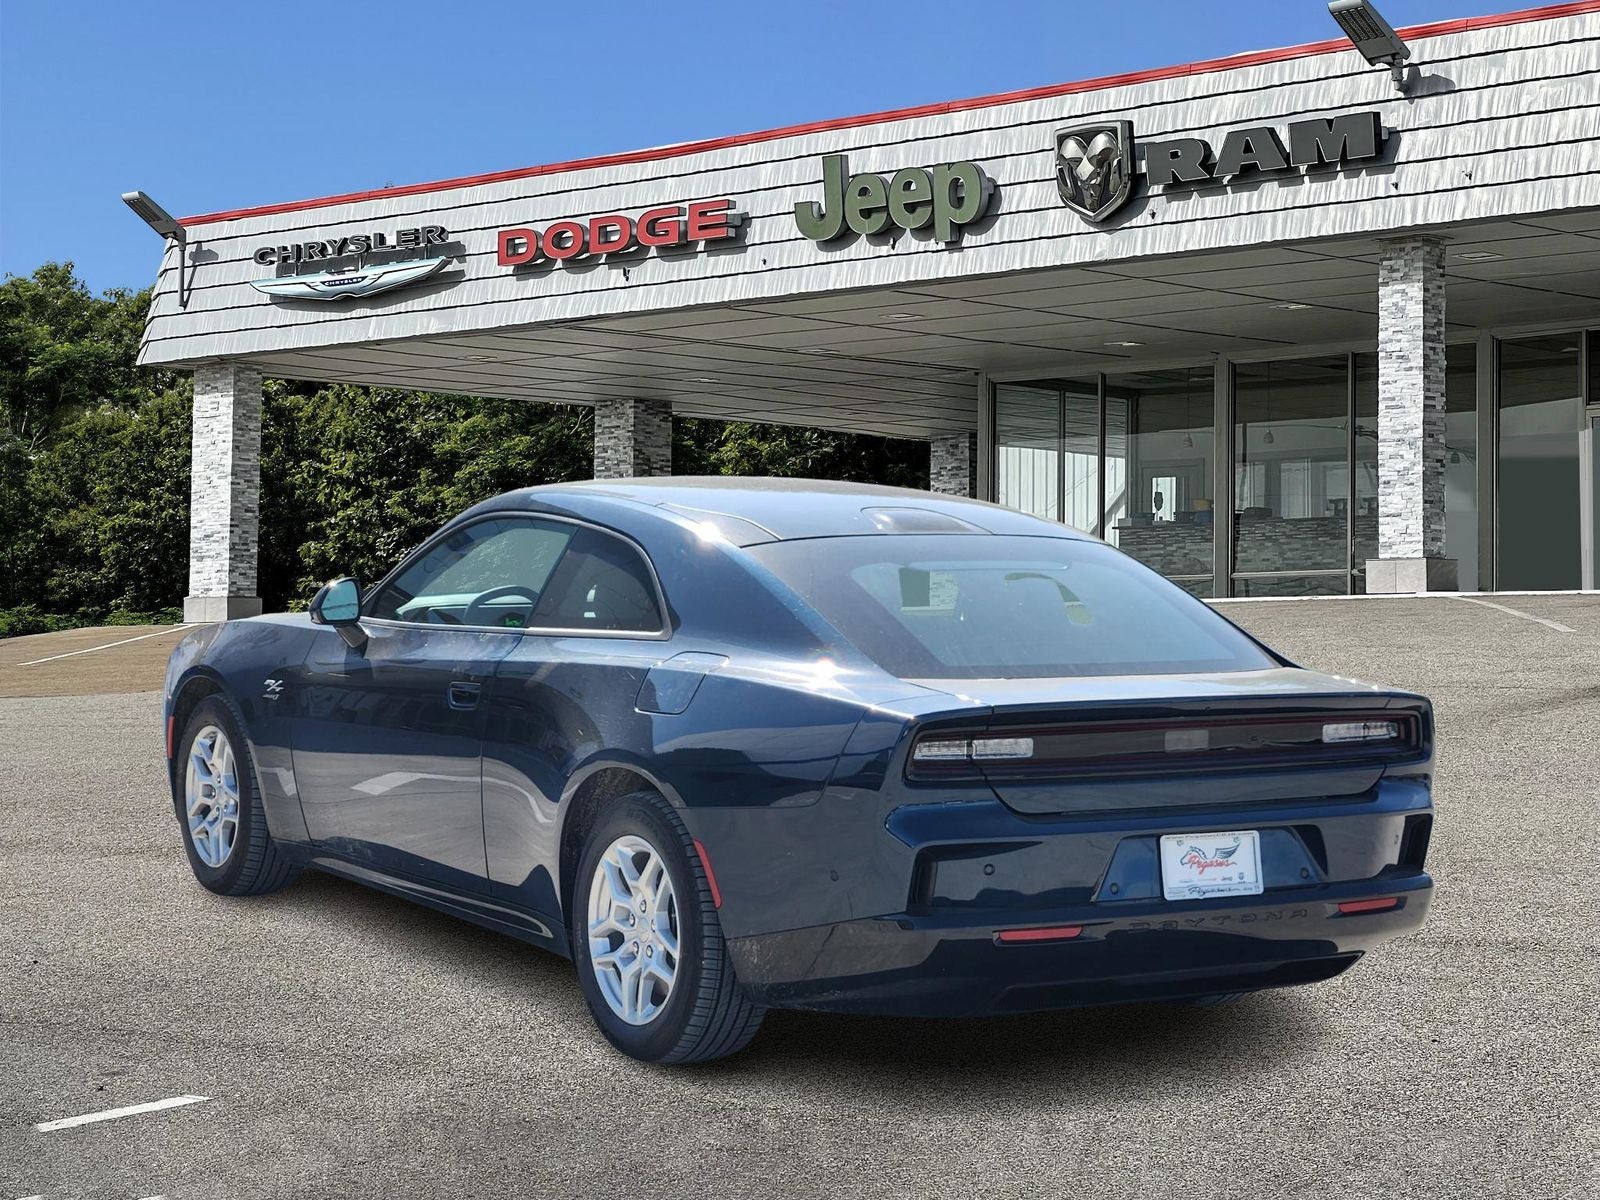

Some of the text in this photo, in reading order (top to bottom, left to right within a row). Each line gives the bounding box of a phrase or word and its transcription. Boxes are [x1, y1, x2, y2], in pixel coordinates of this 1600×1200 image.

[1144, 111, 1381, 186] RAM
[794, 154, 985, 243] Jeep
[253, 225, 448, 266] CHRYSLER
[498, 199, 736, 267] DODGE
[324, 277, 363, 286] CHRYSLER
[1187, 854, 1237, 875] Pegasus
[1128, 908, 1308, 934] DAYTONA
